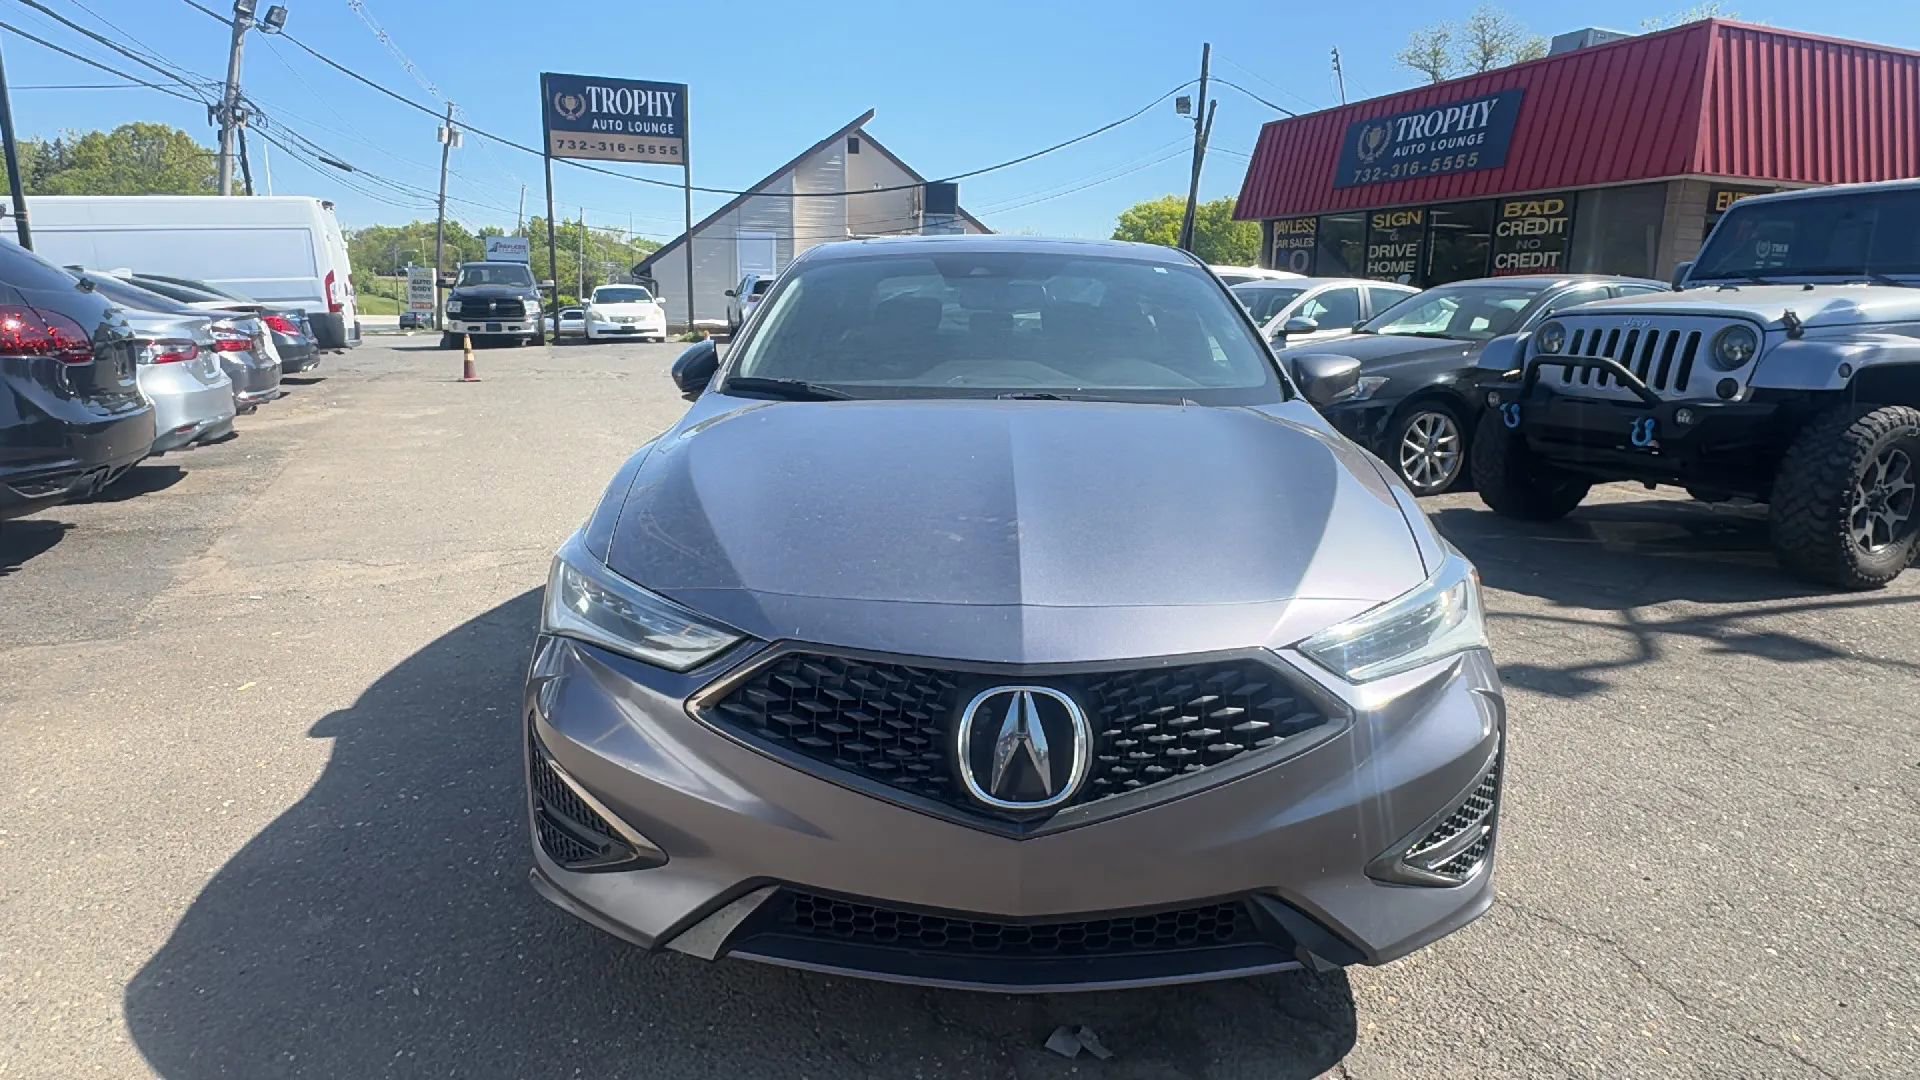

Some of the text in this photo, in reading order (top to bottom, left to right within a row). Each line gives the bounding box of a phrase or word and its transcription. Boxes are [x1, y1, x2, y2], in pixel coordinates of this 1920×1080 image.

[585, 86, 677, 118] TROPHY
[592, 118, 675, 135] AUTO LOUNGE
[1395, 98, 1500, 143] TROPHY
[556, 139, 679, 156] 732-316-5555
[1392, 132, 1486, 158] AUTO LOUNGE
[1353, 151, 1480, 184] 732-316-5555
[1503, 199, 1565, 218] BAD
[1273, 217, 1317, 235] PAYLESS
[1371, 210, 1423, 229] SIGN
[1496, 217, 1569, 237] CREDIT
[1289, 237, 1315, 249] SALES
[1369, 243, 1417, 259] DRIVE
[1516, 238, 1541, 250] NO
[1367, 260, 1416, 273] HOME
[1494, 252, 1561, 269] CREDIT
